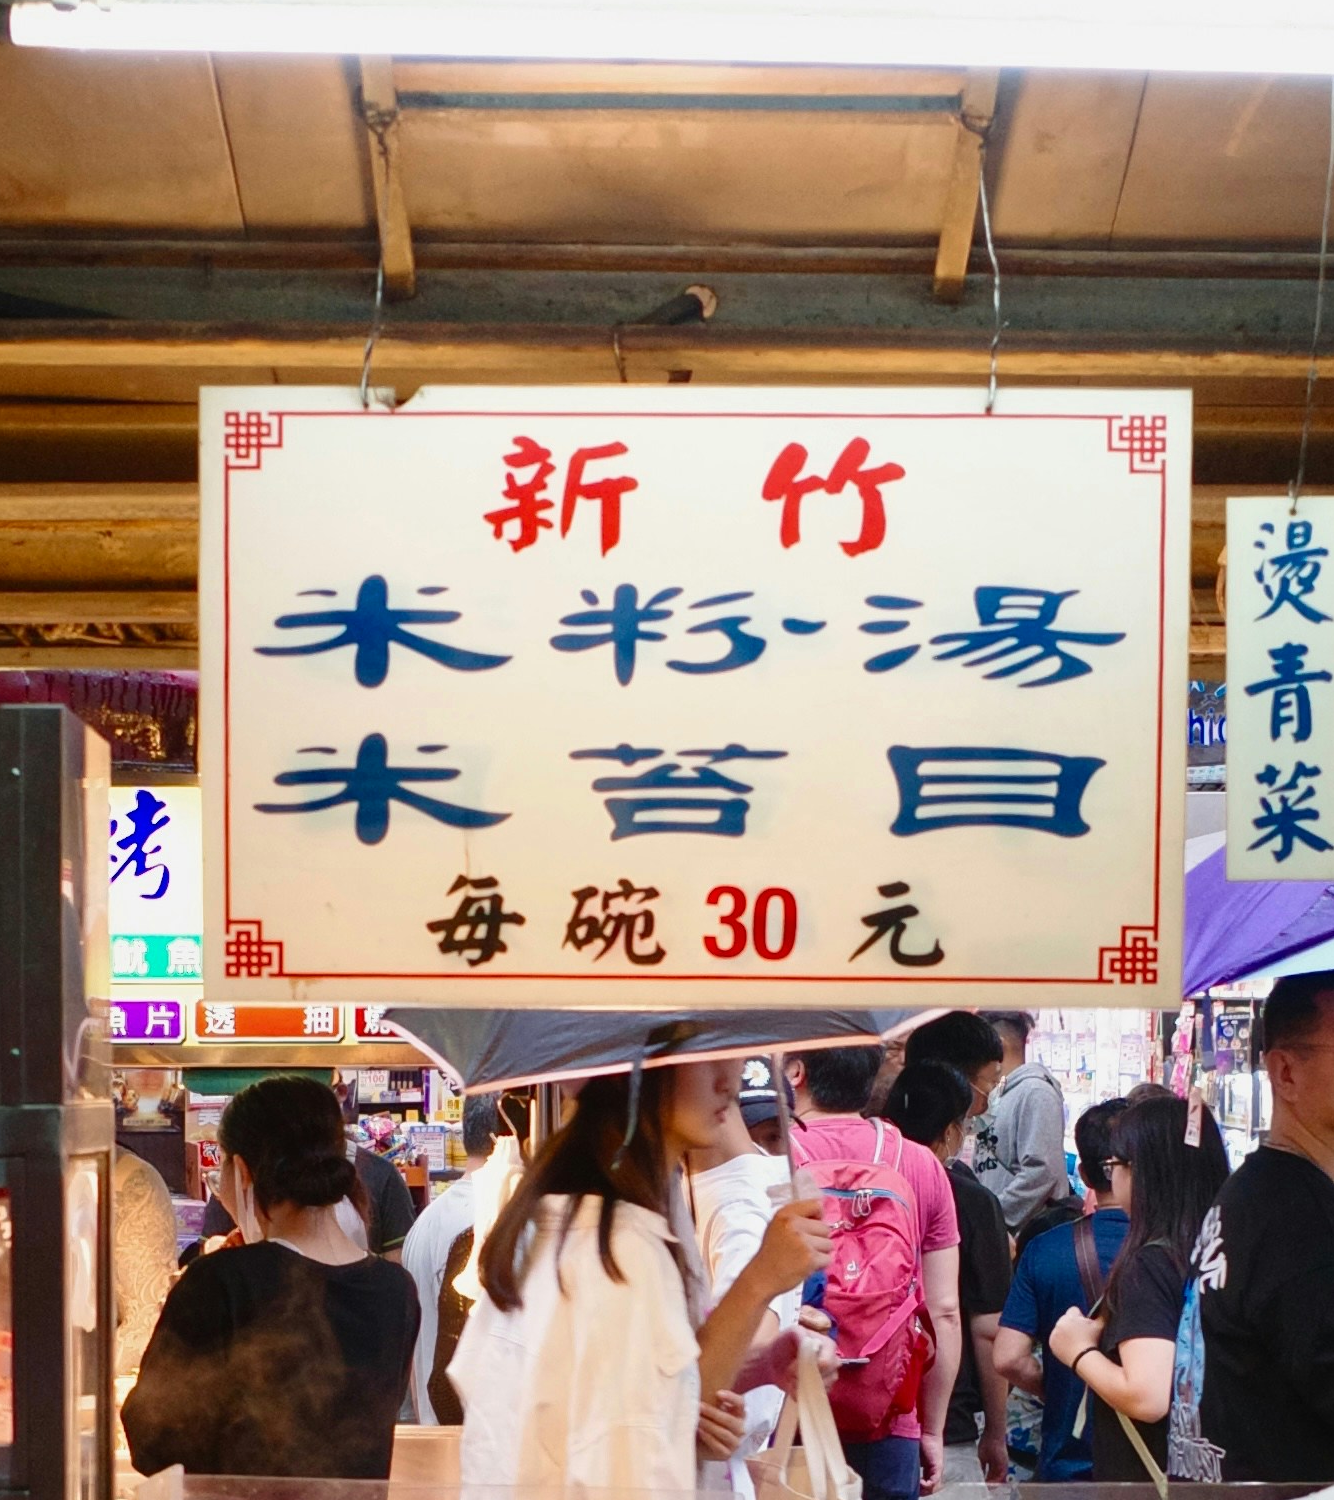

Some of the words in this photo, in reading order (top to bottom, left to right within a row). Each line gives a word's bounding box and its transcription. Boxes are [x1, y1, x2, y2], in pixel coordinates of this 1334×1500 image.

[483, 436, 906, 558] 新竹
[1244, 520, 1334, 863] 燙青菜
[254, 733, 1107, 845] 米苔目
